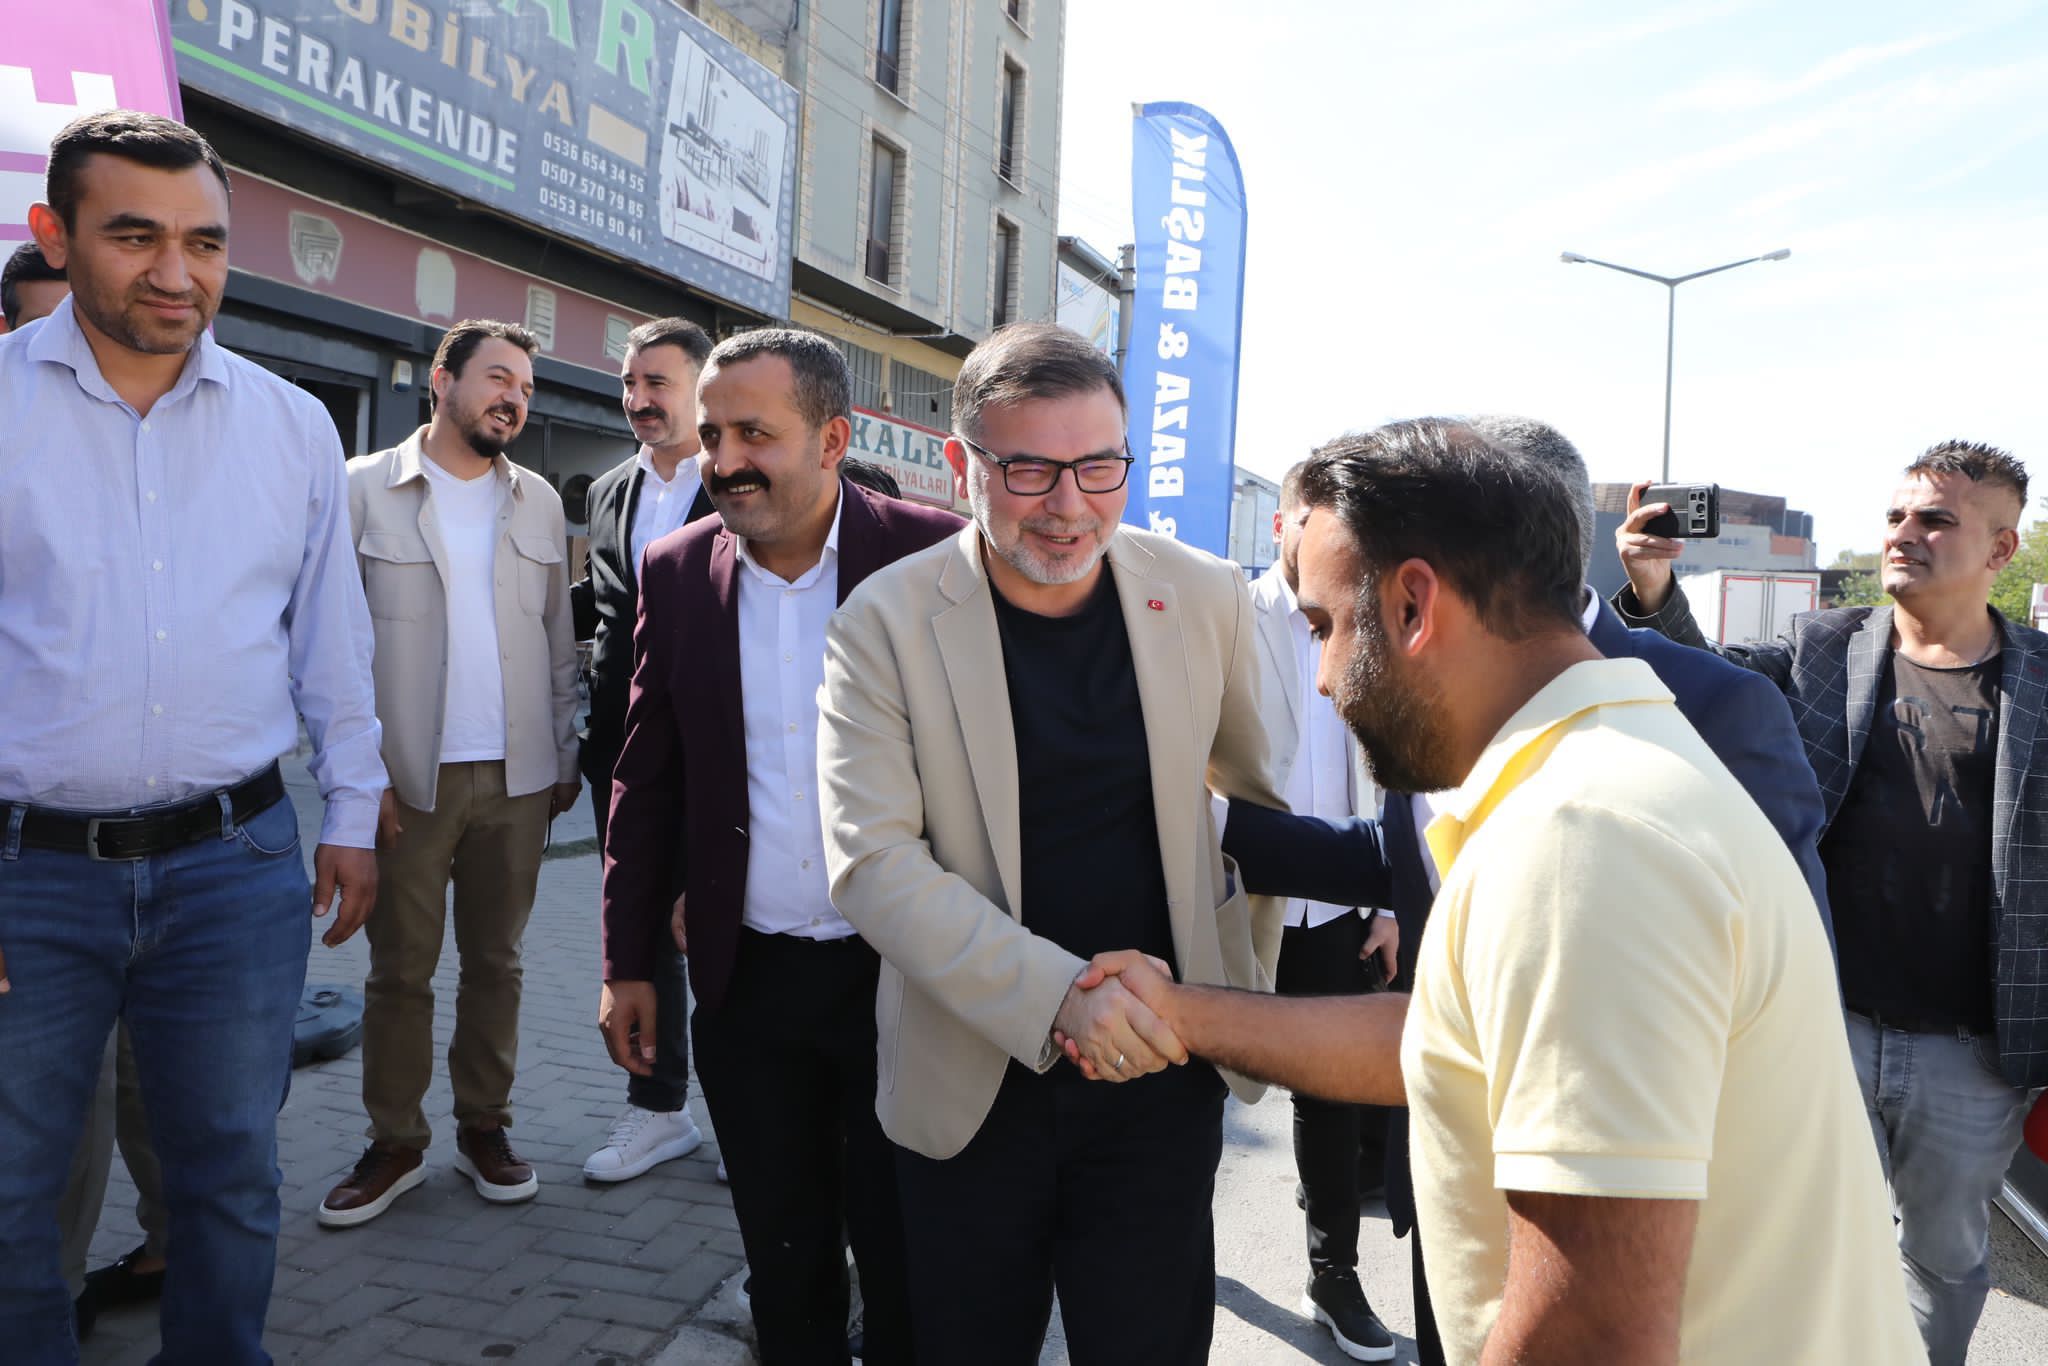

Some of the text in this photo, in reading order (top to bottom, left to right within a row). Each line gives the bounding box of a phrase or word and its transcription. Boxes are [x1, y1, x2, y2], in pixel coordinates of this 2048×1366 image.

[218, 0, 517, 175] PERAKENDE
[541, 159, 577, 188] 0507
[580, 177, 606, 201] 570
[608, 190, 625, 210] 79
[543, 131, 645, 193] 0536 654 34 55
[539, 186, 576, 216] 0553
[608, 216, 625, 237] 90
[628, 225, 643, 245] 41
[850, 414, 944, 470] KALE
